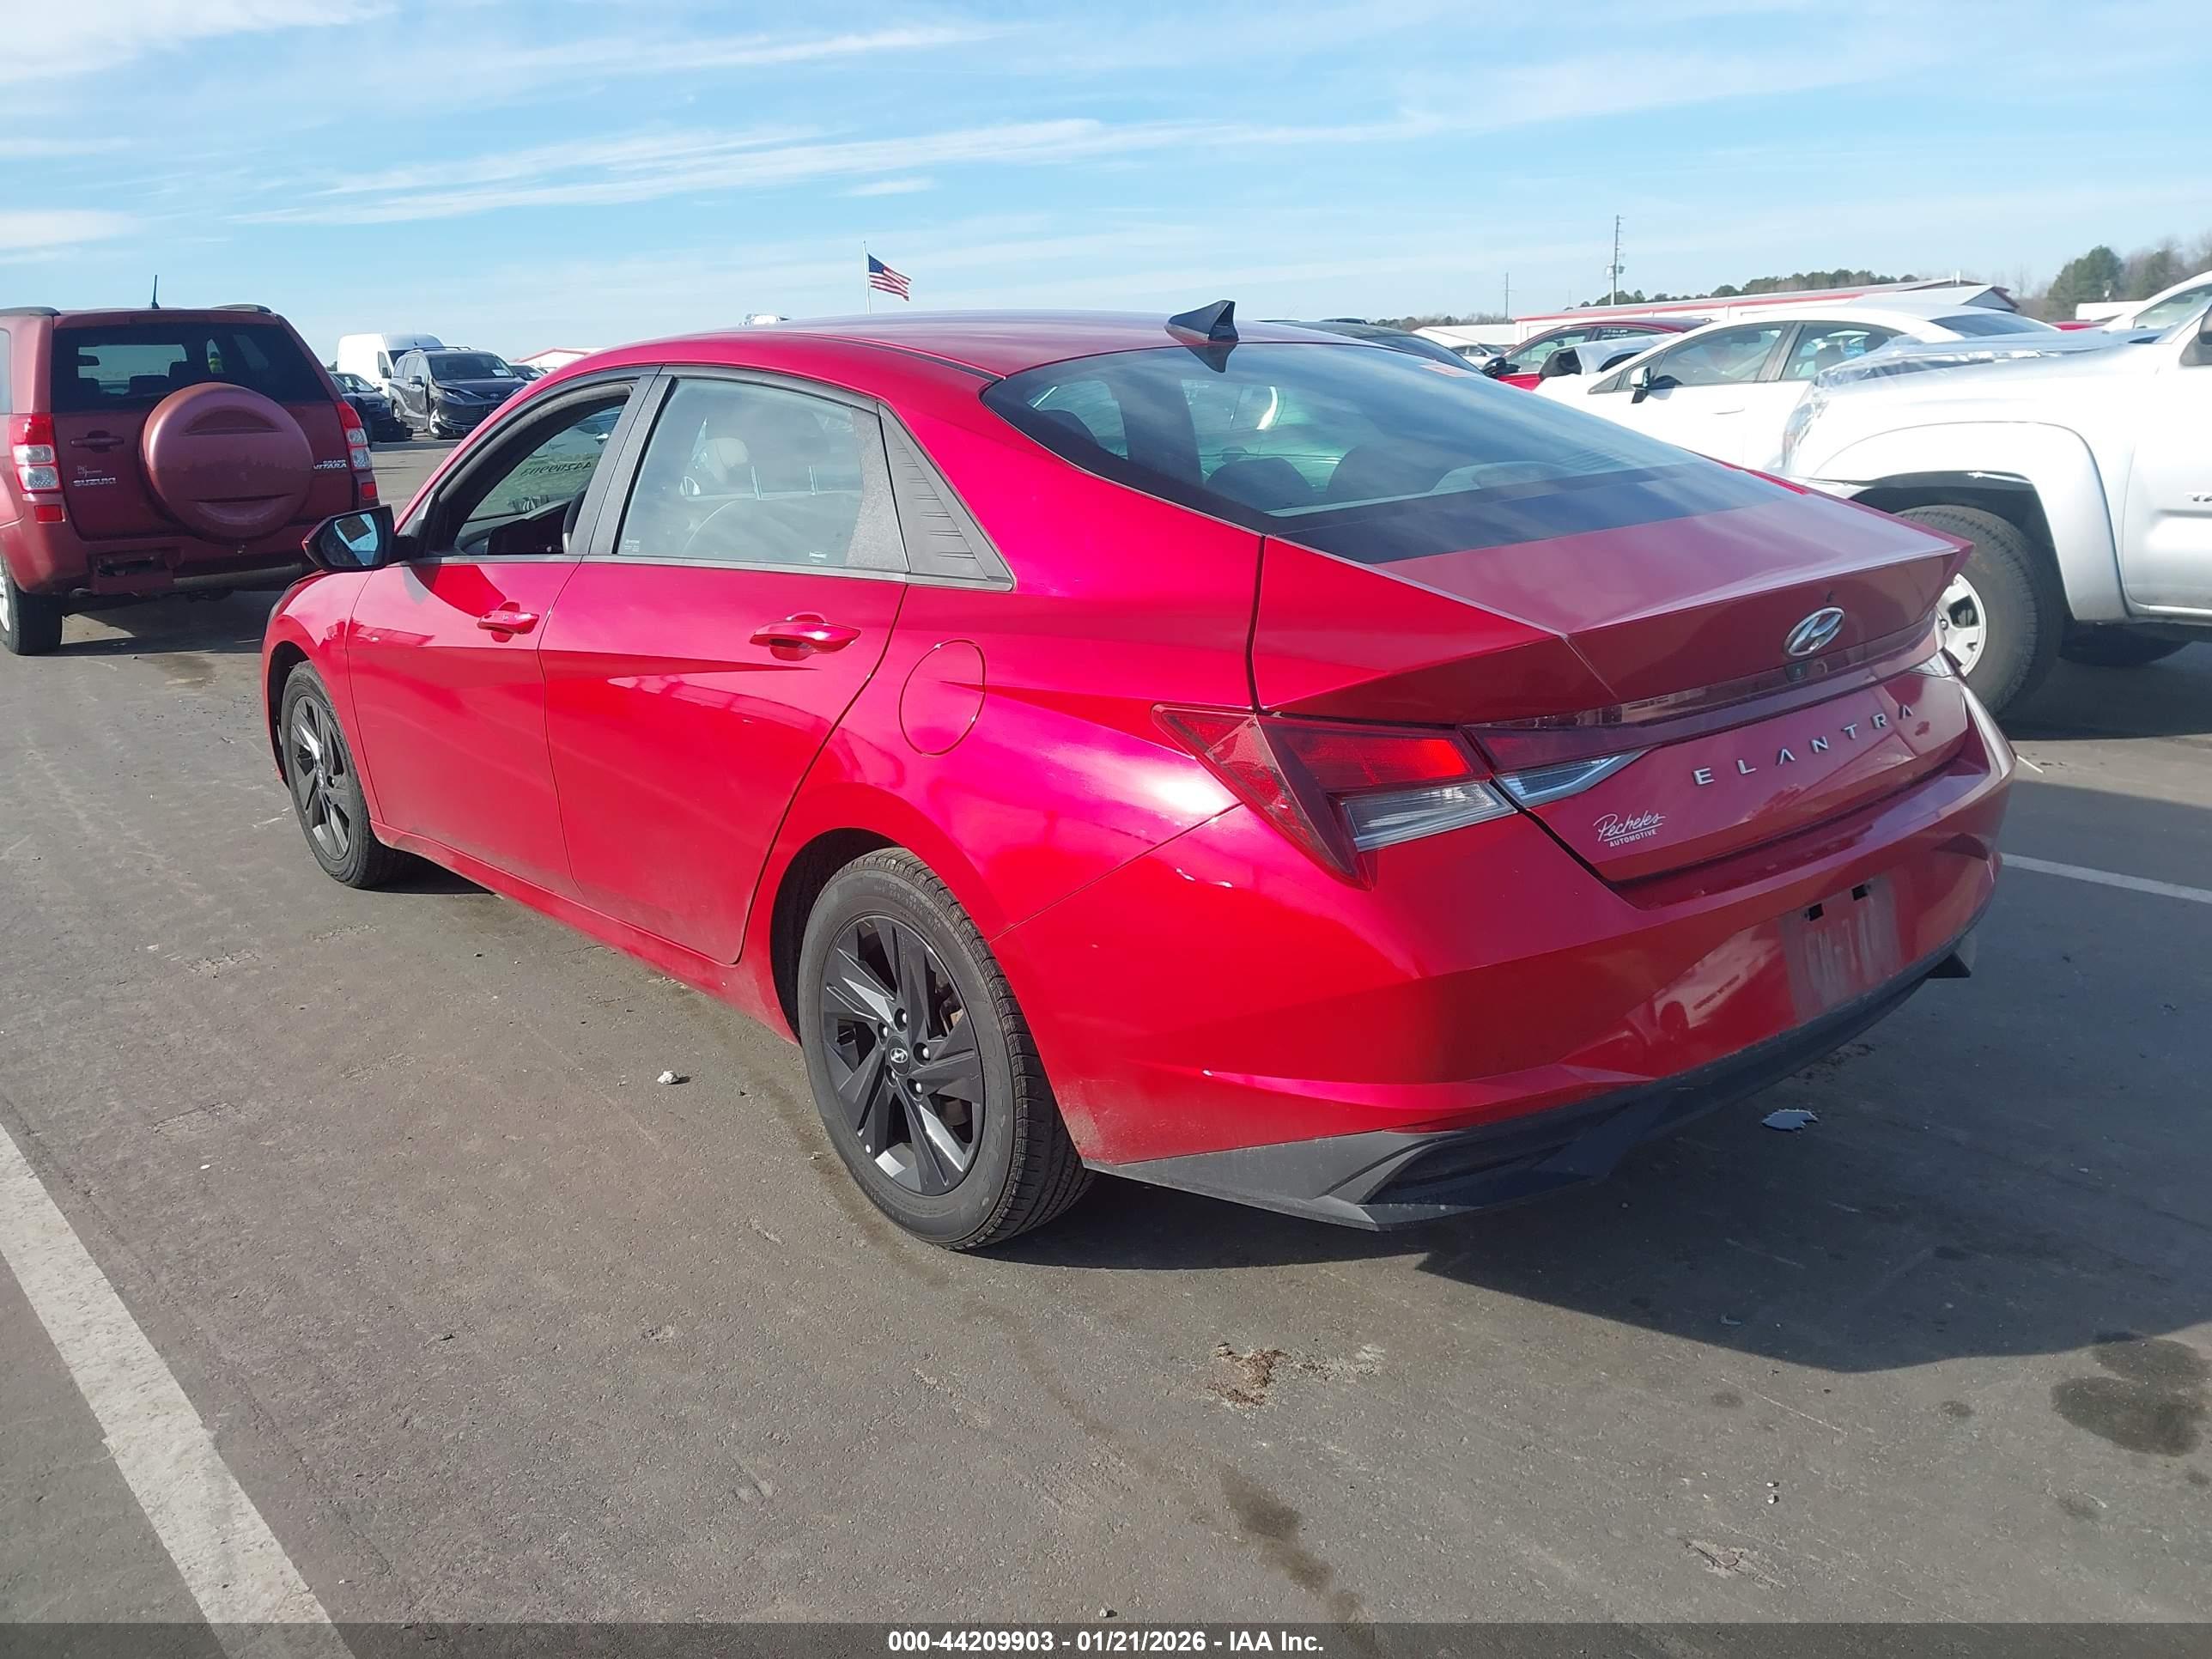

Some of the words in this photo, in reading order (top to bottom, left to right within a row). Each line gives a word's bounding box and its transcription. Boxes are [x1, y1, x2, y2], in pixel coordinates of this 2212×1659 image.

[72, 477, 117, 487] SUZUKI
[1693, 704, 1914, 785] ELANTRA
[1593, 810, 1666, 842] Pecheles
[1609, 829, 1658, 848] AUTOMOTIVE
